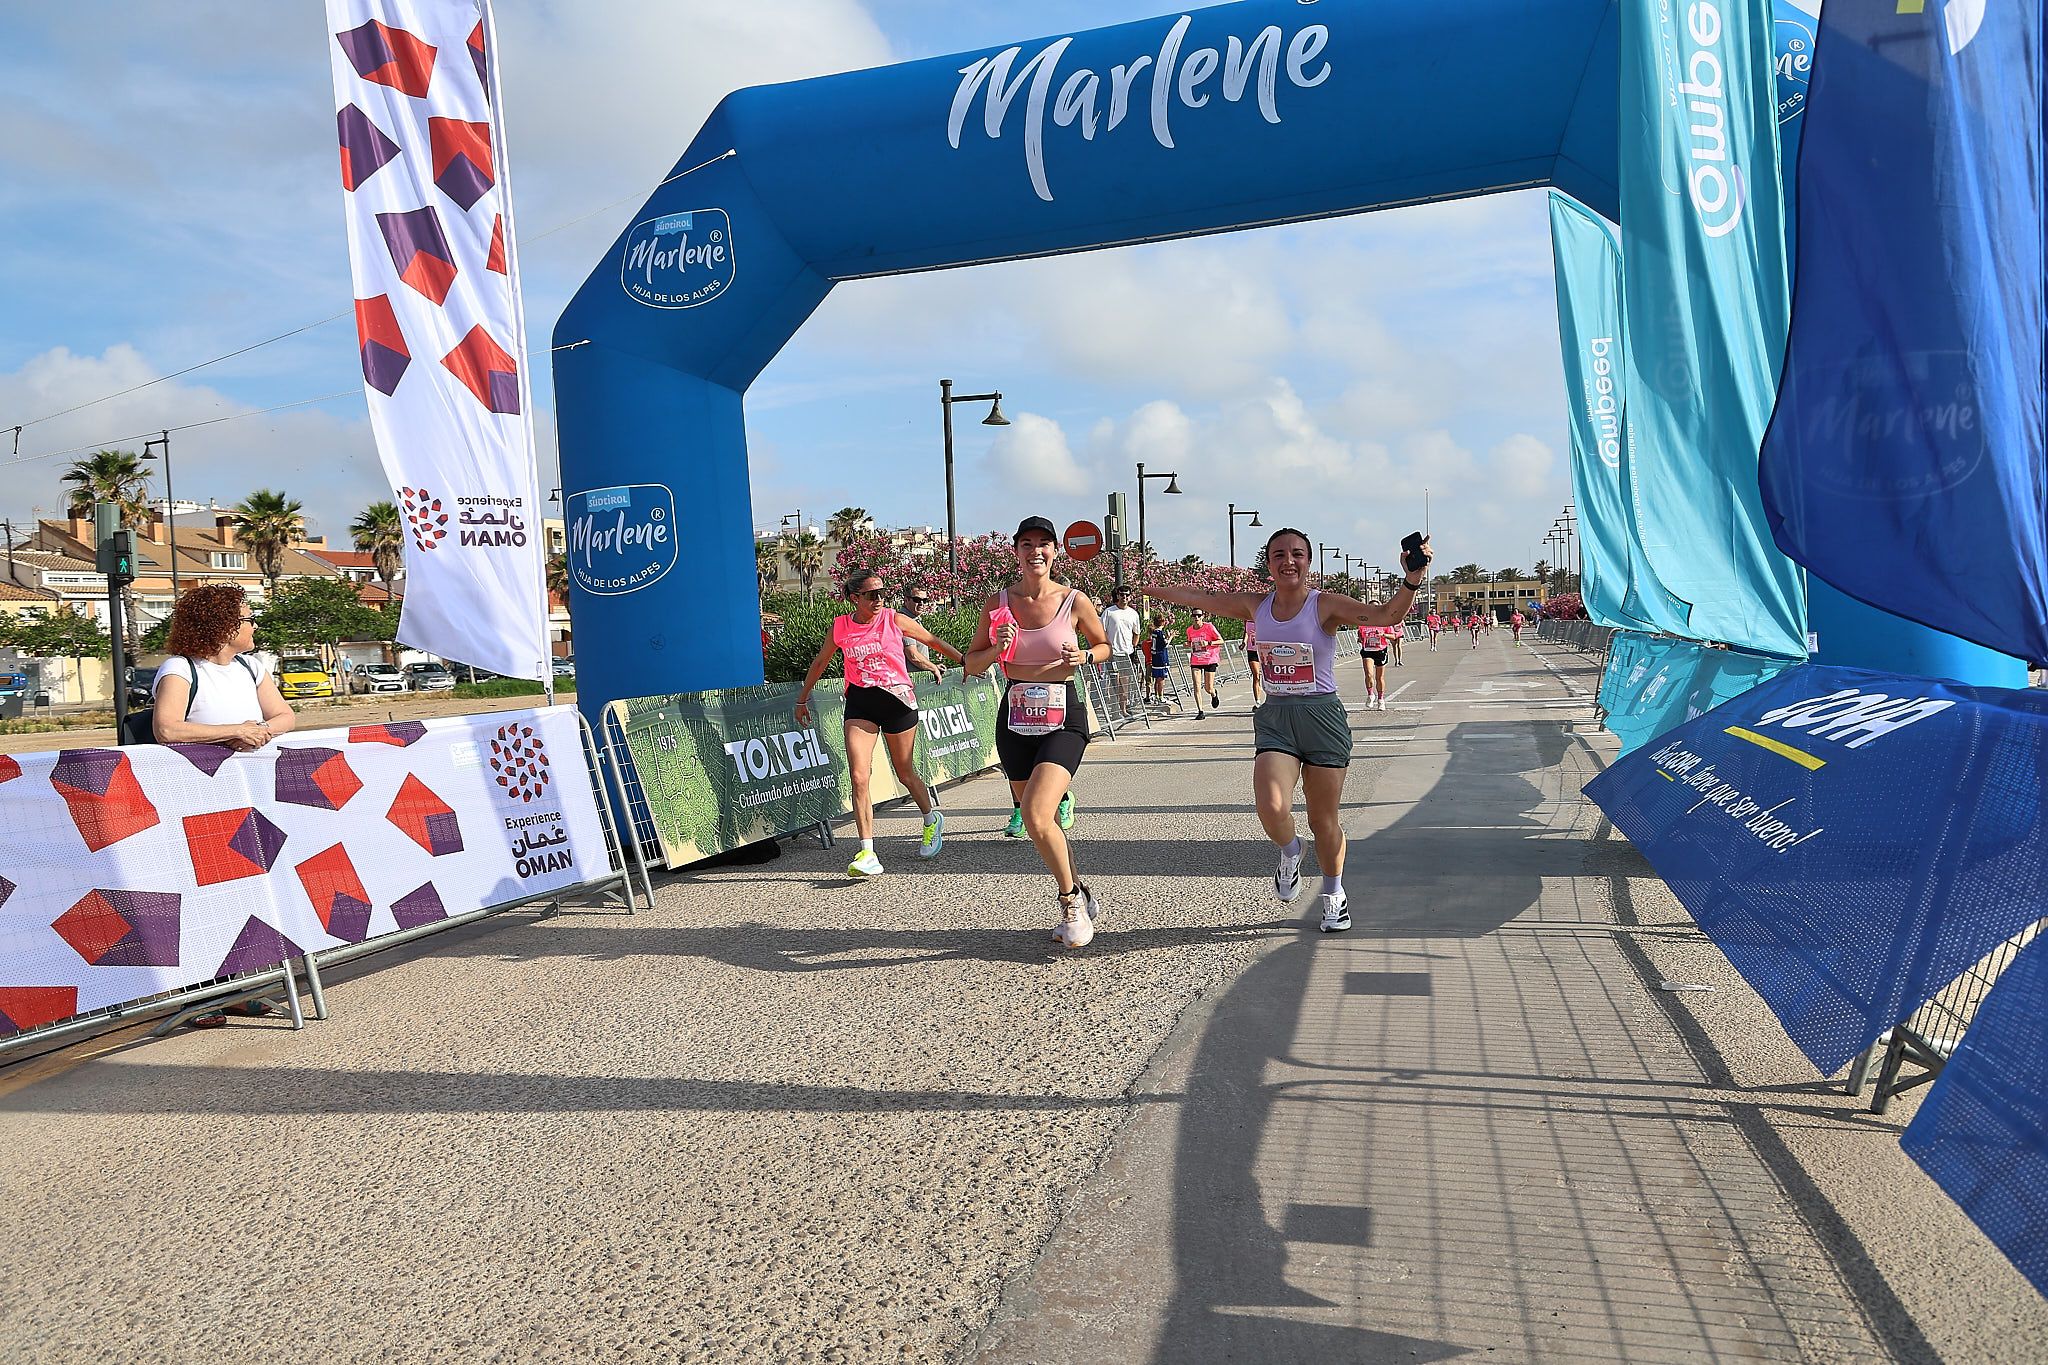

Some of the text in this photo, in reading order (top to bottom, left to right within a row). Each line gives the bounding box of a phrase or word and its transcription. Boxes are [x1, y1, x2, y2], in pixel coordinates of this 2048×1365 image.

[947, 15, 1332, 201] Marlene
[1778, 92, 1804, 116] PES
[629, 233, 726, 284] Marlene
[632, 279, 721, 303] HIJA DE LOS ALPES
[573, 510, 668, 569] Marlene
[577, 561, 661, 588] HIJA DE LOS ALPES
[845, 642, 883, 659] CARRERA
[1273, 665, 1296, 675] 016
[1025, 707, 1047, 716] 016
[1753, 688, 1956, 749] GOYA
[657, 734, 678, 752] 1975
[739, 774, 836, 809] Cuidando de ti desde 1975
[505, 810, 562, 831] Experience
[1687, 783, 1740, 814] que
[1725, 796, 1760, 819] ser
[1745, 797, 1824, 854] bueno!
[515, 848, 573, 879] OMAN
